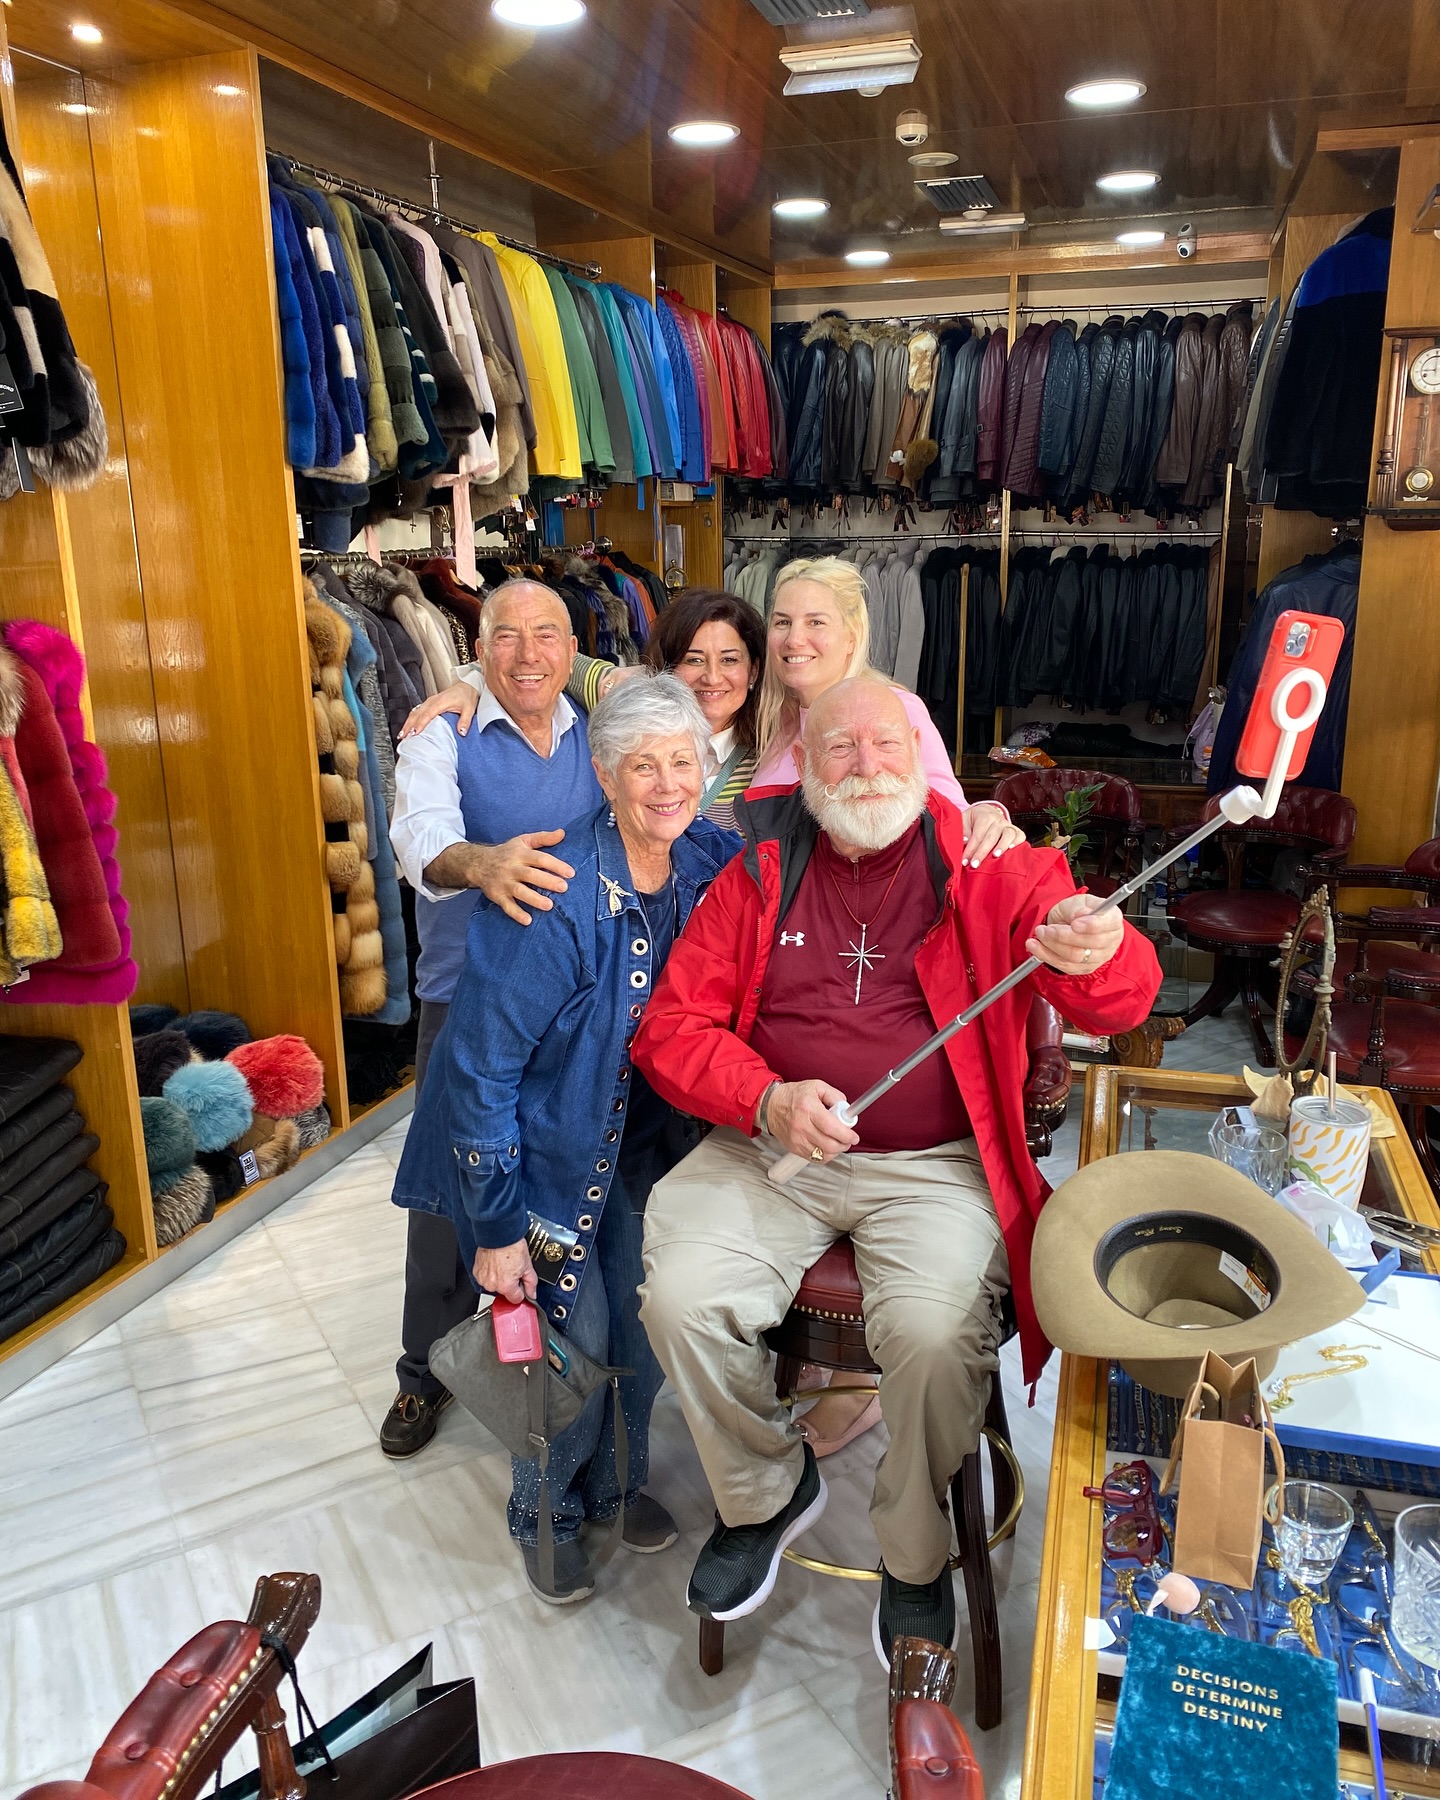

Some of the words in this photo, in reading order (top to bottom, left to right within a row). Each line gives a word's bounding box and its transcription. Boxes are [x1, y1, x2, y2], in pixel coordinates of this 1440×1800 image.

[1171, 1680, 1283, 1719] DETERMINE
[1177, 1665, 1279, 1700] DECISIONS
[1183, 1701, 1268, 1733] DESTINY
